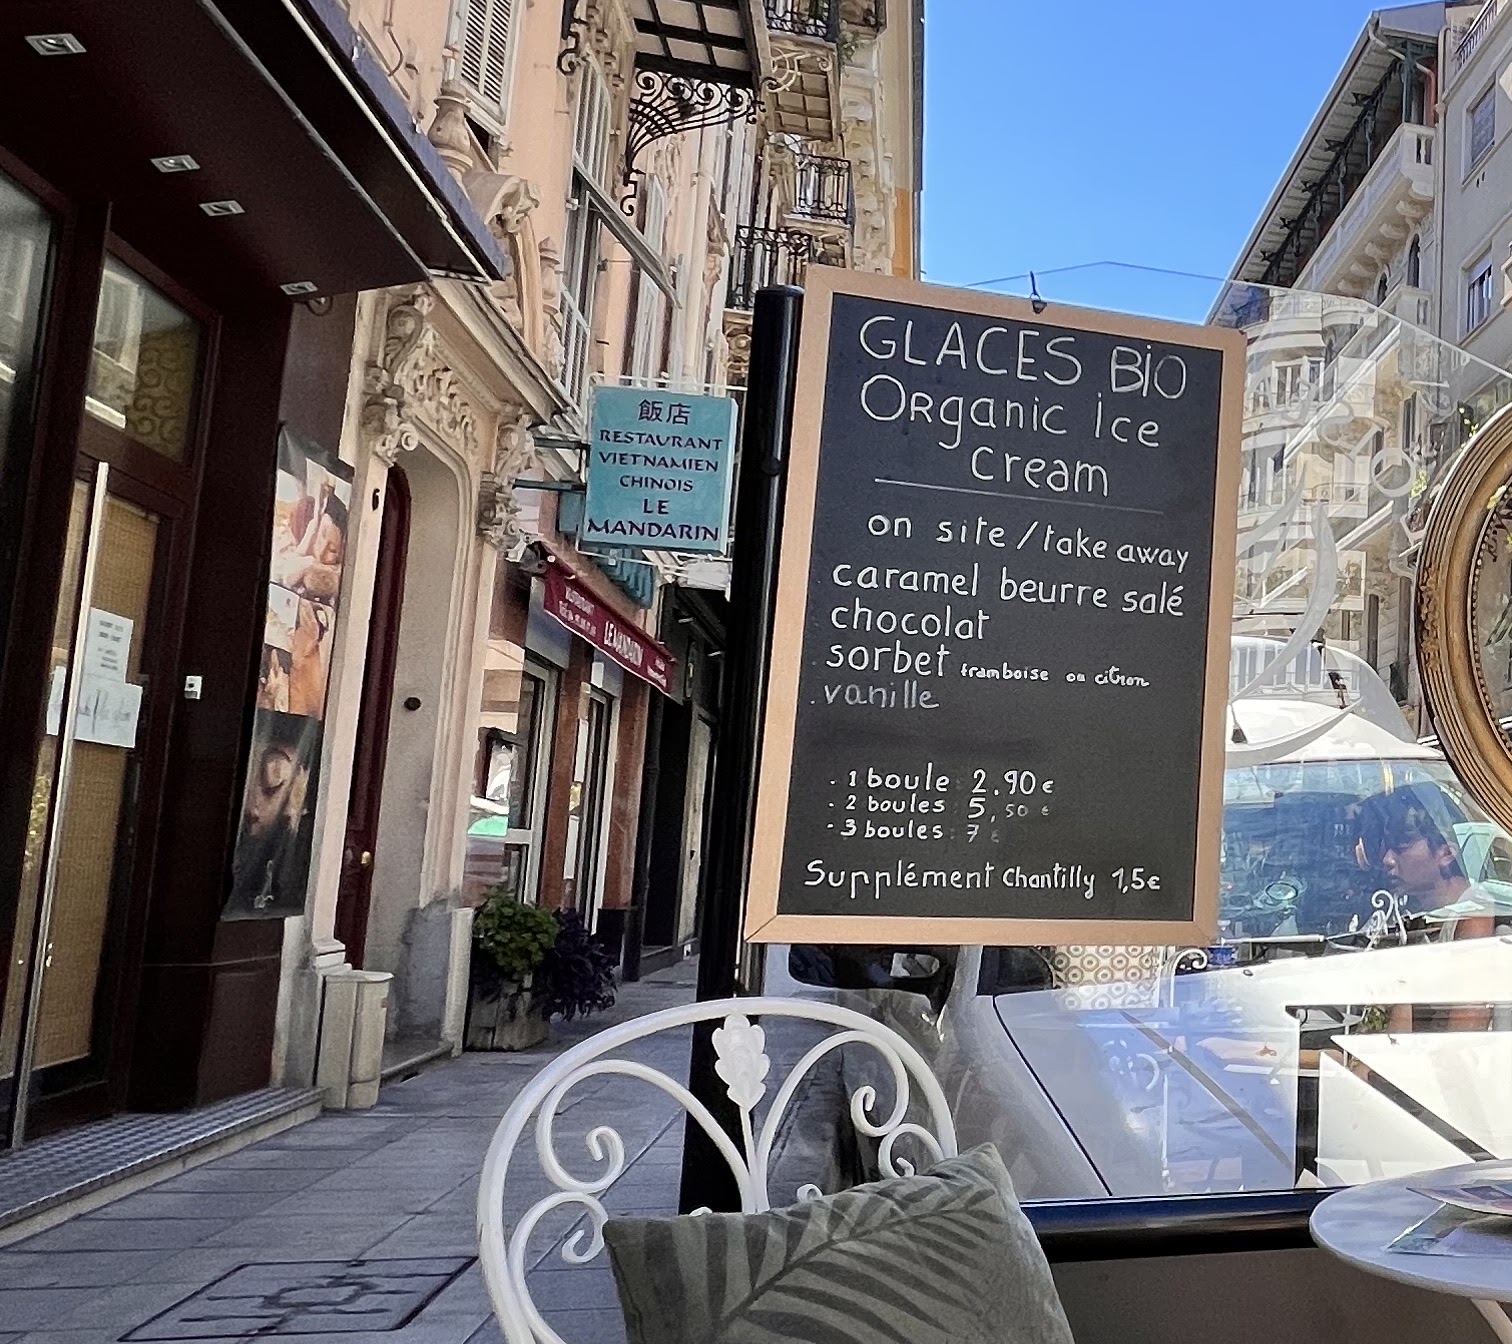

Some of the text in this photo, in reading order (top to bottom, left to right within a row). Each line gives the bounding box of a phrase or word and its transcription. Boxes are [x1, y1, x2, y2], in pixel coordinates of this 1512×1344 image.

[859, 315, 1083, 386] GLACES
[638, 399, 691, 425] 飯店
[600, 429, 723, 451] RESTAURANT
[598, 451, 719, 472] VIETNAMIEN
[619, 475, 694, 492] CHINOIS
[643, 498, 670, 515] LE
[587, 518, 719, 542] MANDARIN
[867, 514, 913, 539] on
[936, 516, 1006, 548] site
[1116, 541, 1189, 573] away
[832, 562, 1185, 617] caramel beurre salé
[831, 597, 990, 640] chocolat
[825, 640, 951, 677] sorbet
[1094, 666, 1151, 688] citron
[824, 679, 941, 710] vanille
[848, 769, 858, 787] 1
[867, 762, 951, 793] boule
[845, 794, 857, 810] 2
[867, 793, 946, 813] boules
[840, 818, 858, 837] 3
[804, 858, 995, 899] Supplément
[1002, 861, 1095, 899] Chantilly
